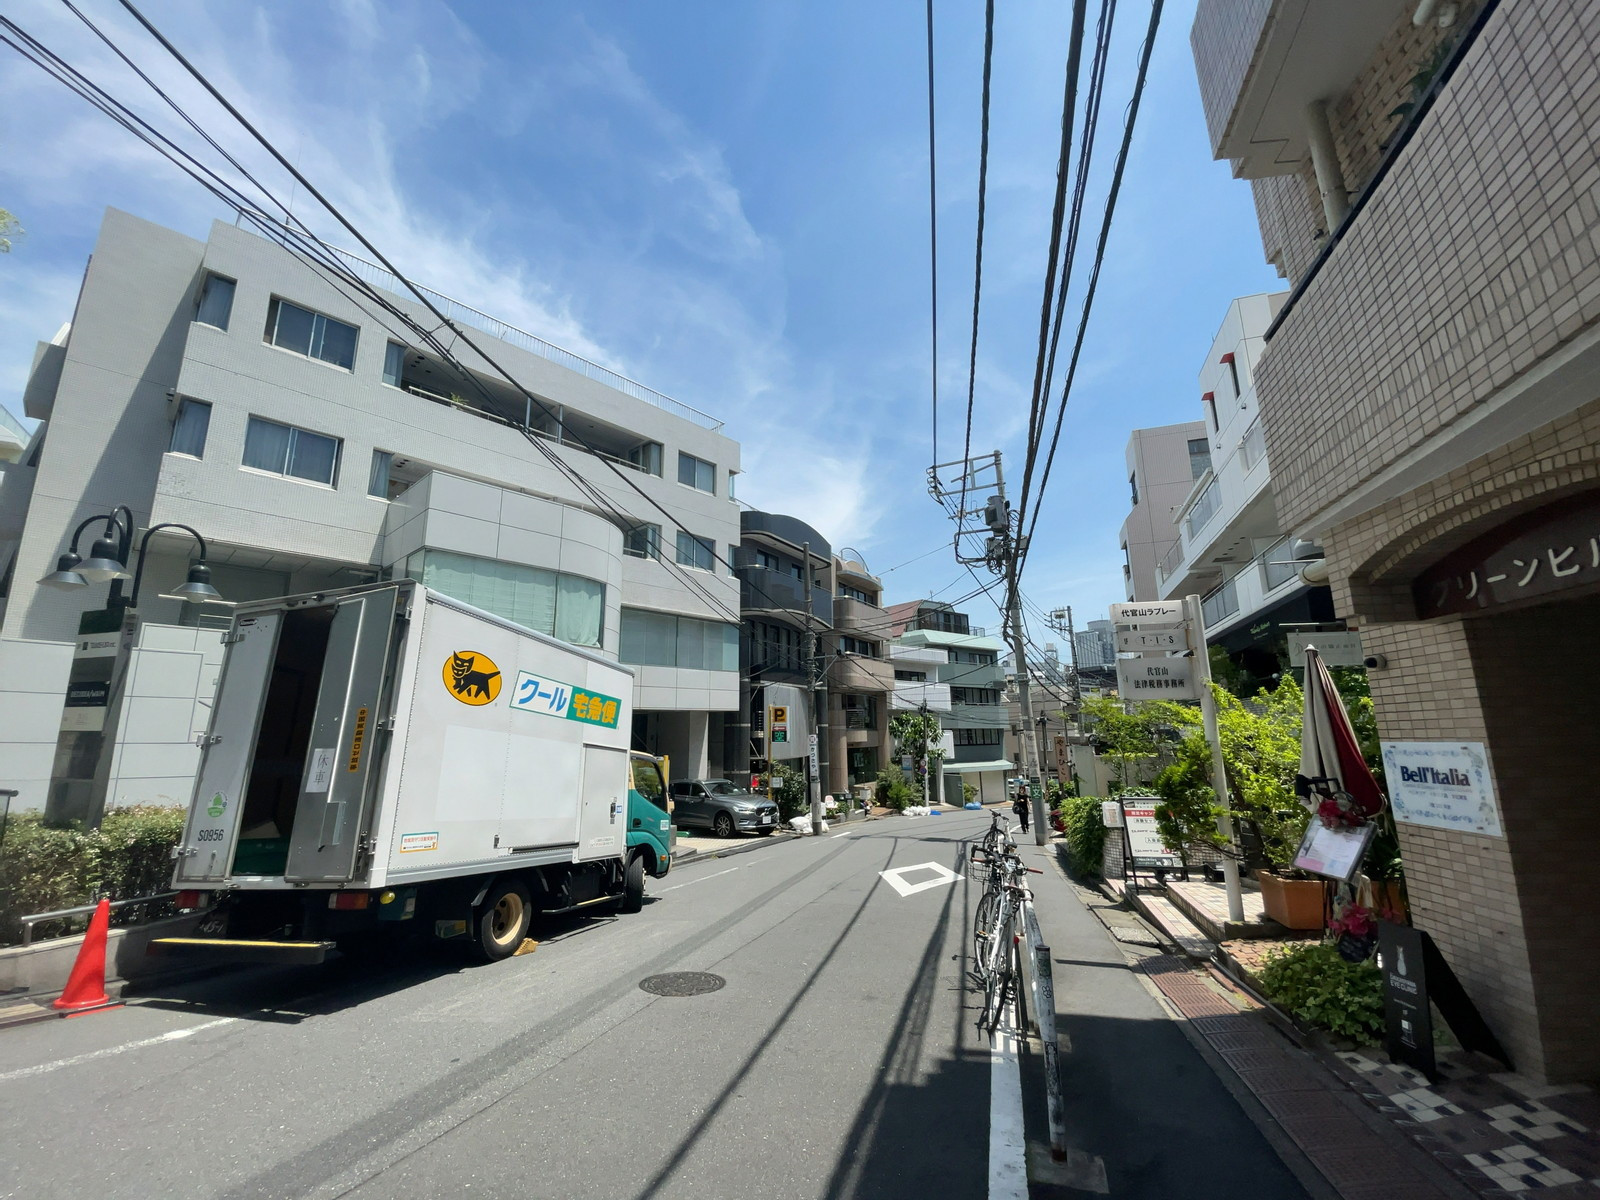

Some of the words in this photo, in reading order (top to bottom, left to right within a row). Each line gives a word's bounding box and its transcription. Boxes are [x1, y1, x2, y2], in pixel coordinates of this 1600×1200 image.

[1147, 667, 1169, 676] 代官山
[774, 708, 784, 722] P
[313, 754, 329, 785] 休車
[1400, 766, 1470, 787] Bell'Italia
